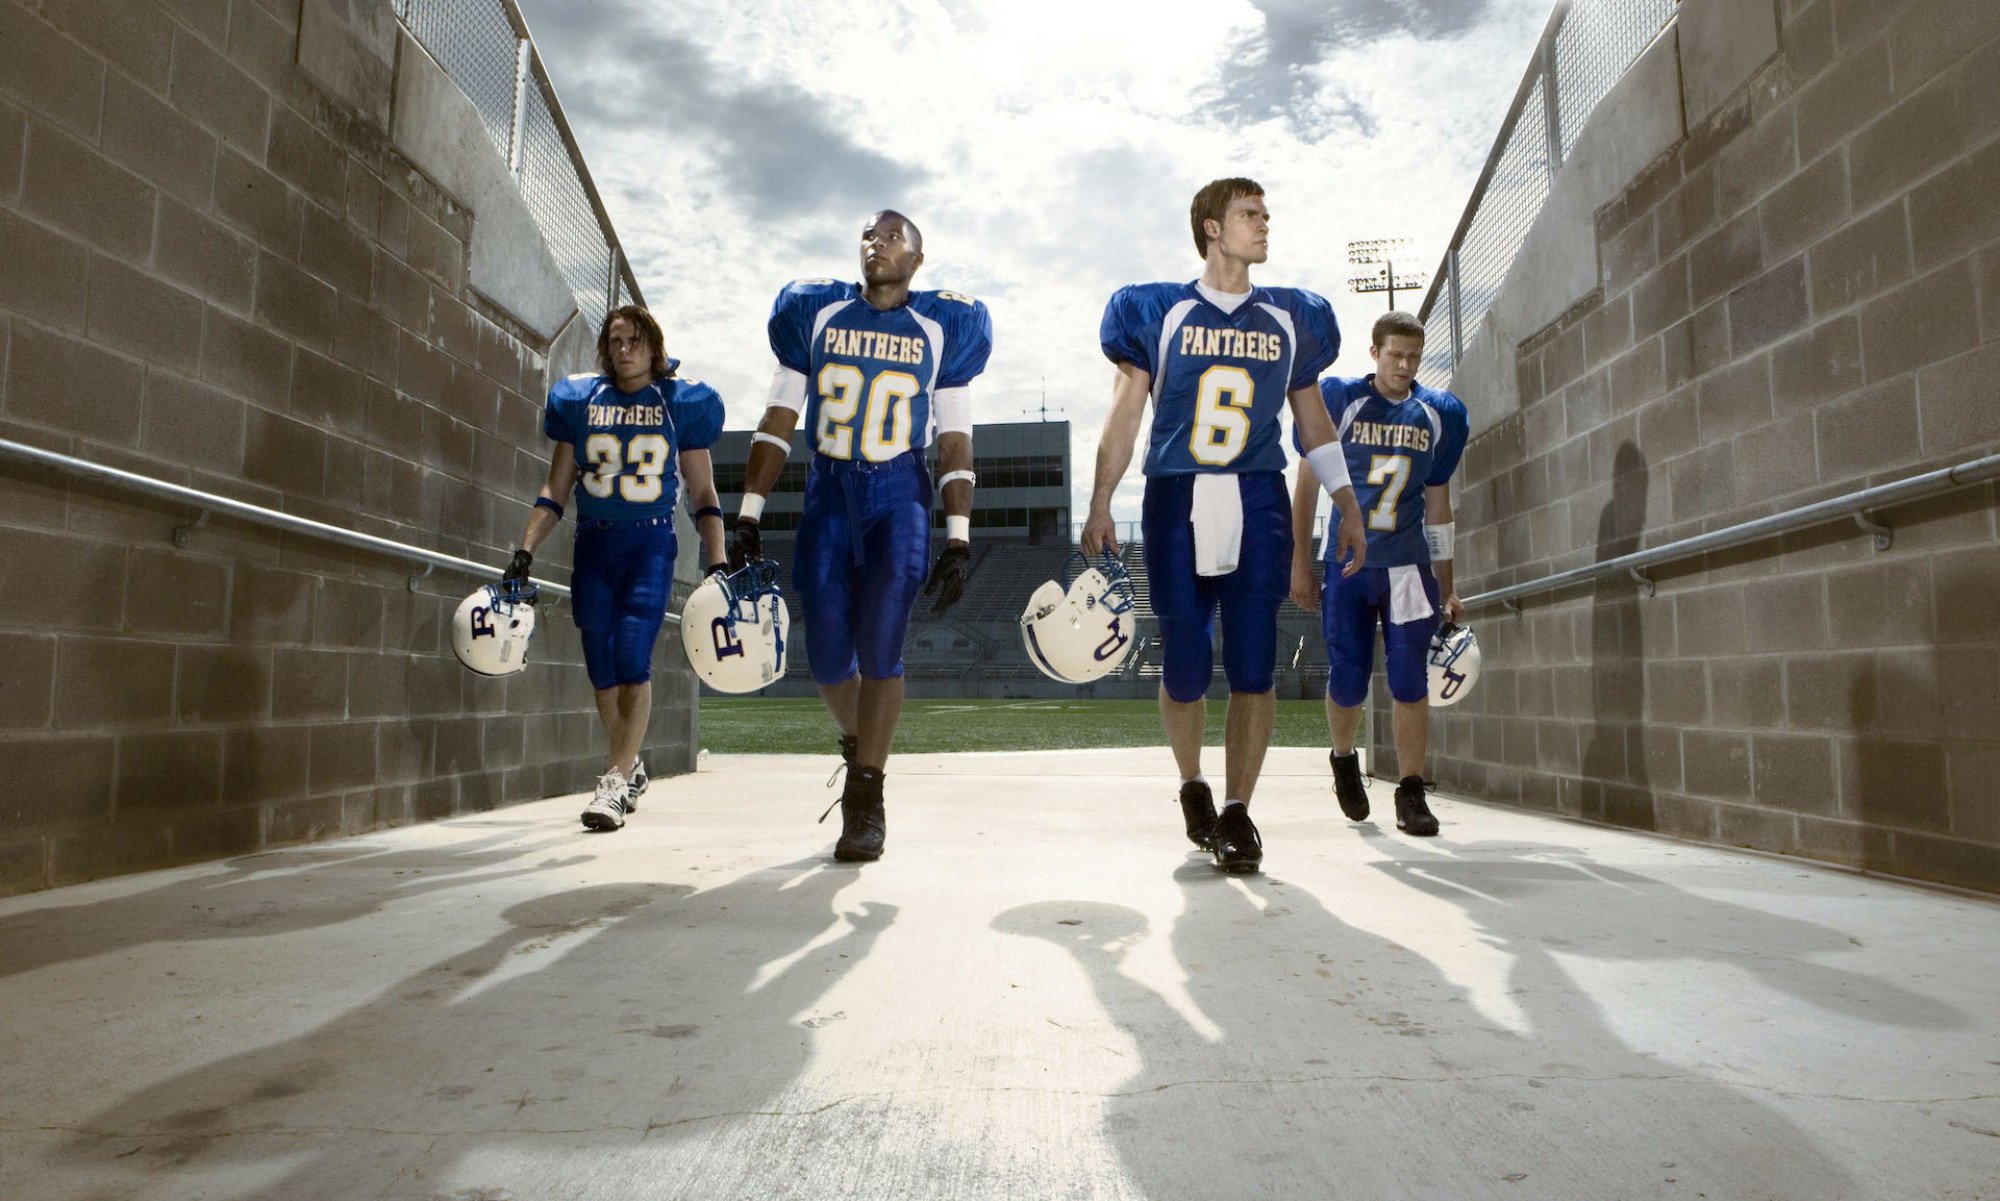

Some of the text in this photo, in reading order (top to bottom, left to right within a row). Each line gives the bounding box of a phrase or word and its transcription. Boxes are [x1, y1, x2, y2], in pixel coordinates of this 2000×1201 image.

[824, 327, 924, 365] PANTHERS
[1180, 326, 1281, 362] PANTHERS
[588, 404, 664, 426] PANTHERS
[817, 363, 920, 463] 20
[1188, 365, 1255, 467] 6
[1351, 421, 1430, 452] PANTHERS
[582, 433, 670, 502] 33
[1367, 454, 1412, 532] 7
